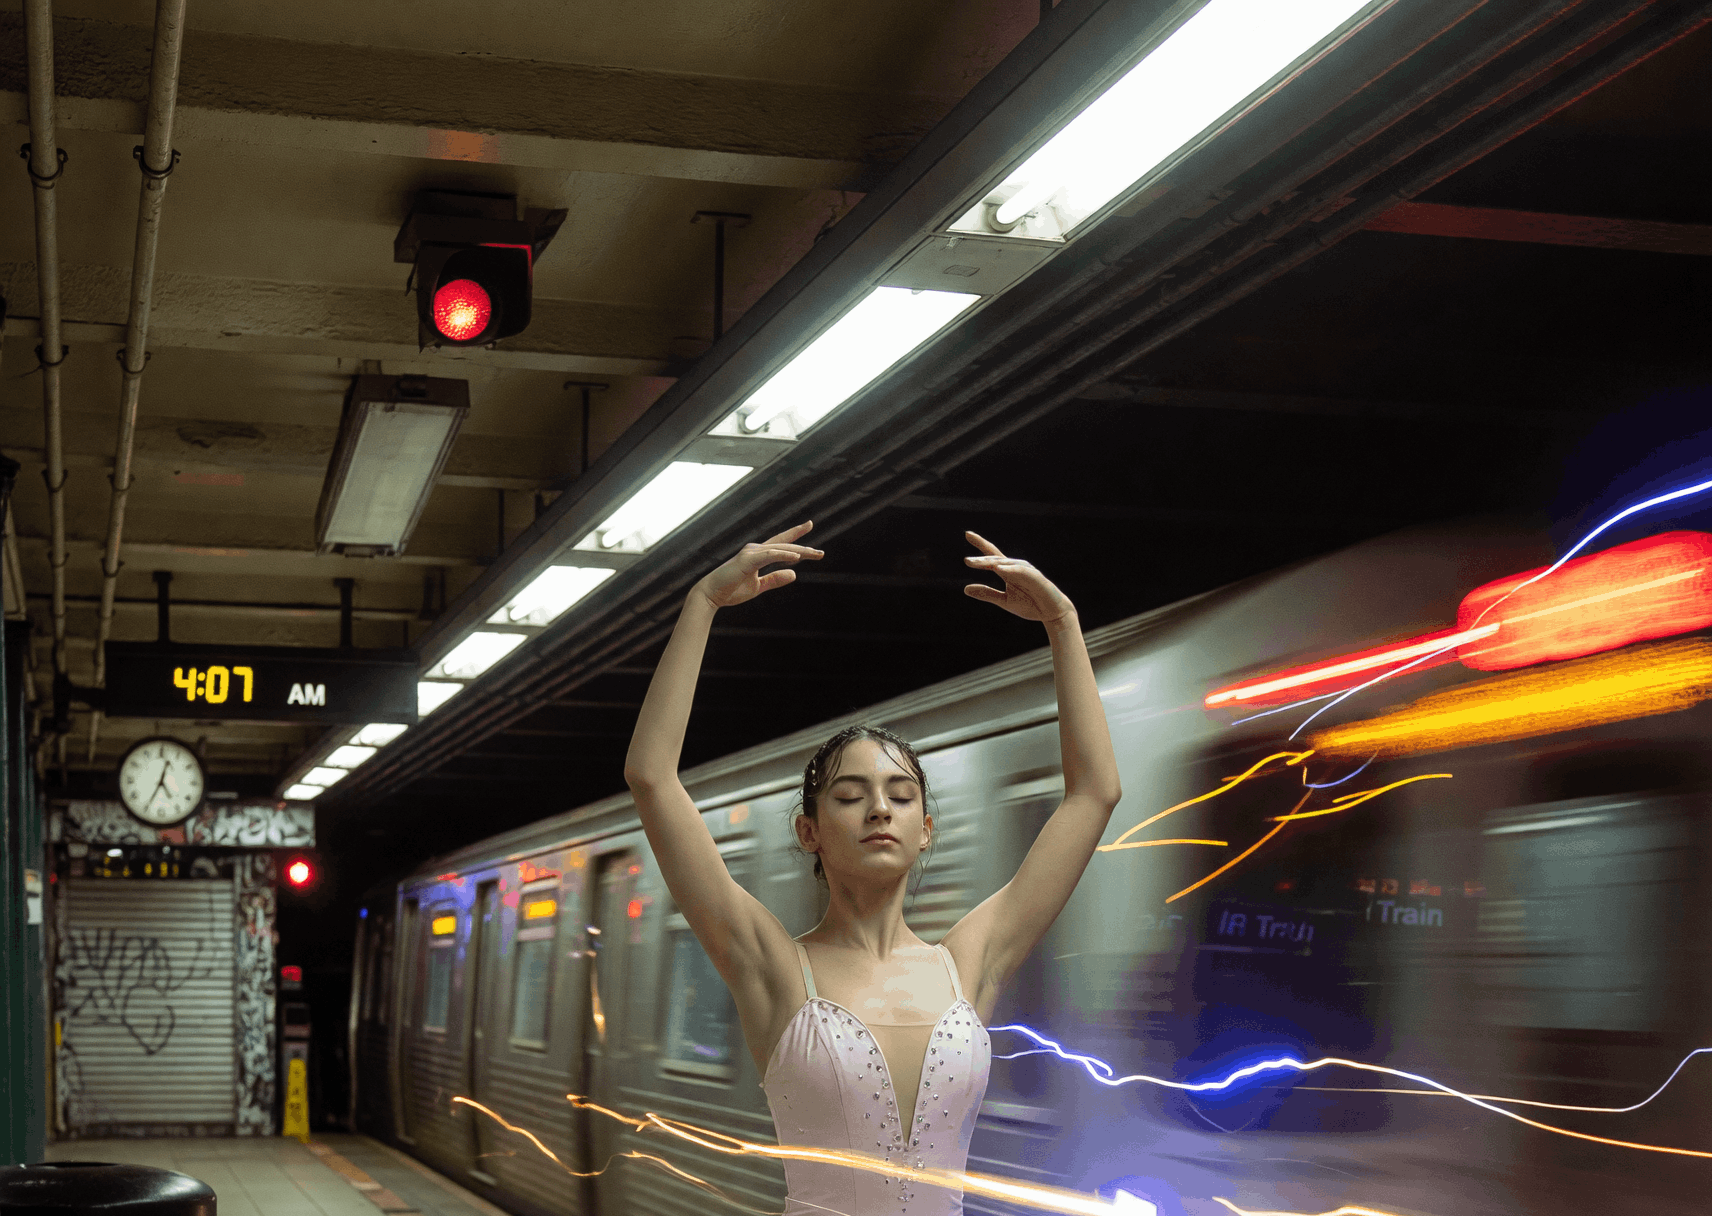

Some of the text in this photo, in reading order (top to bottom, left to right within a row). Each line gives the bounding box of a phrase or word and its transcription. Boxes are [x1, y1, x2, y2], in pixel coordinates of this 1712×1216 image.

[174, 666, 325, 706] 4:07 AM
[1378, 900, 1443, 927] Train
